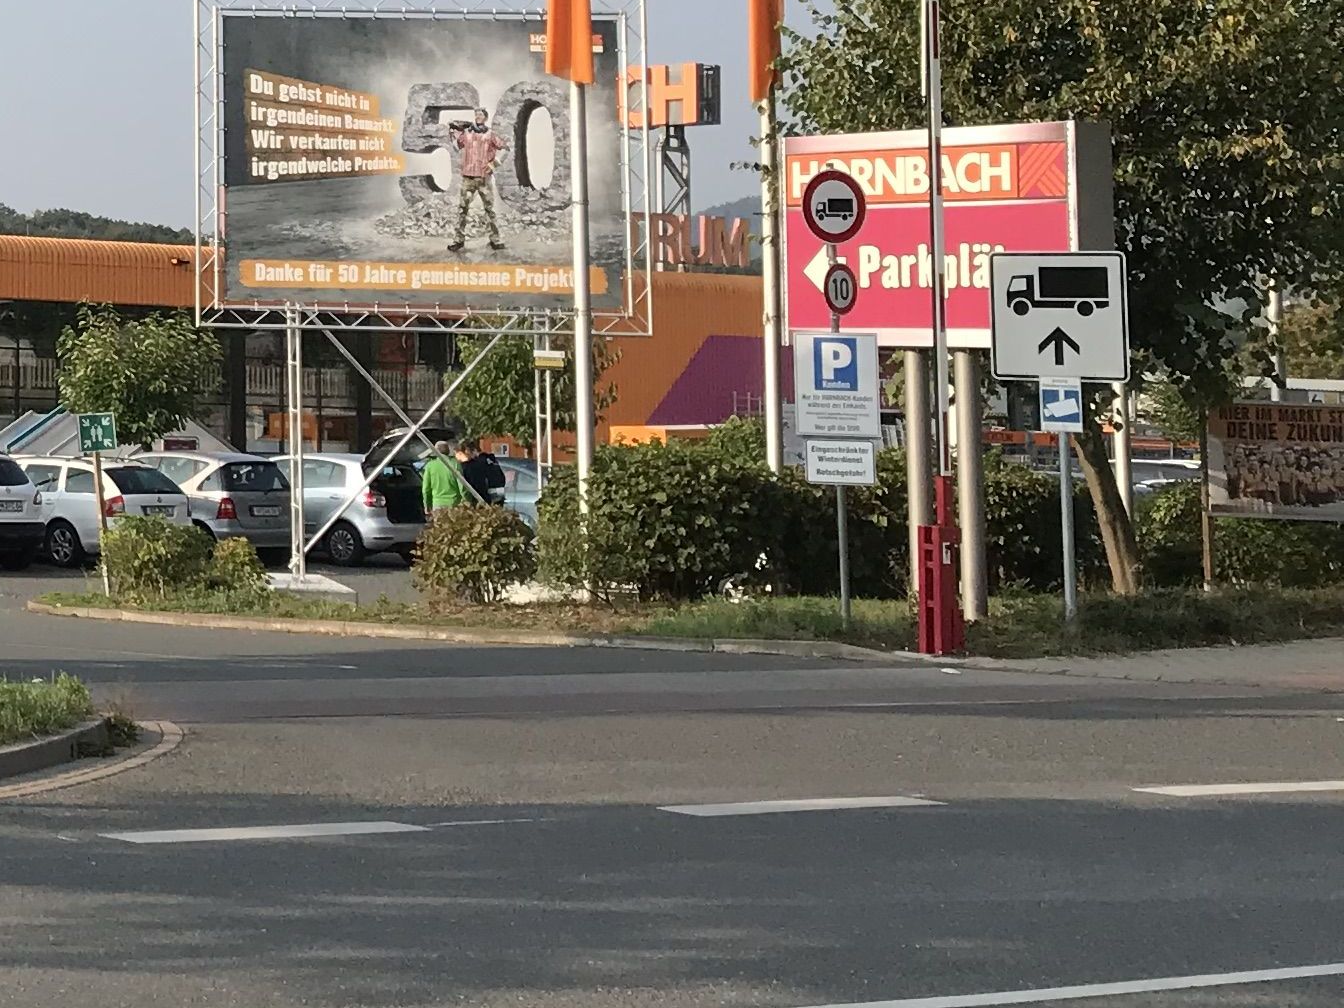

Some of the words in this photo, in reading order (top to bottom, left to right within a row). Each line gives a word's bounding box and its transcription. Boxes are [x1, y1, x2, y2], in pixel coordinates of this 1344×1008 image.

[250, 73, 274, 96] Du
[278, 83, 323, 103] gehst
[325, 90, 358, 110] nicht
[359, 95, 370, 111] in
[250, 102, 342, 128] irgendeinen
[344, 113, 395, 132] Baumarkt.
[251, 129, 285, 150] Wir
[289, 133, 357, 152] verkaufen
[358, 139, 385, 152] nicht
[251, 156, 352, 181] irgendwelche
[354, 156, 401, 172] Produkte.
[255, 262, 304, 283] Danke
[308, 263, 334, 283] für
[338, 264, 360, 284] 50
[362, 264, 407, 285] Jahre
[411, 265, 511, 289] gemeinsame
[515, 268, 576, 292] Projekt
[858, 242, 1006, 299] Parkplä
[832, 277, 849, 301] 10
[821, 342, 852, 380] P
[1218, 406, 1250, 421] HIER
[1255, 407, 1272, 422] IM
[1278, 408, 1323, 423] MARKT
[1226, 421, 1279, 441] DEINE
